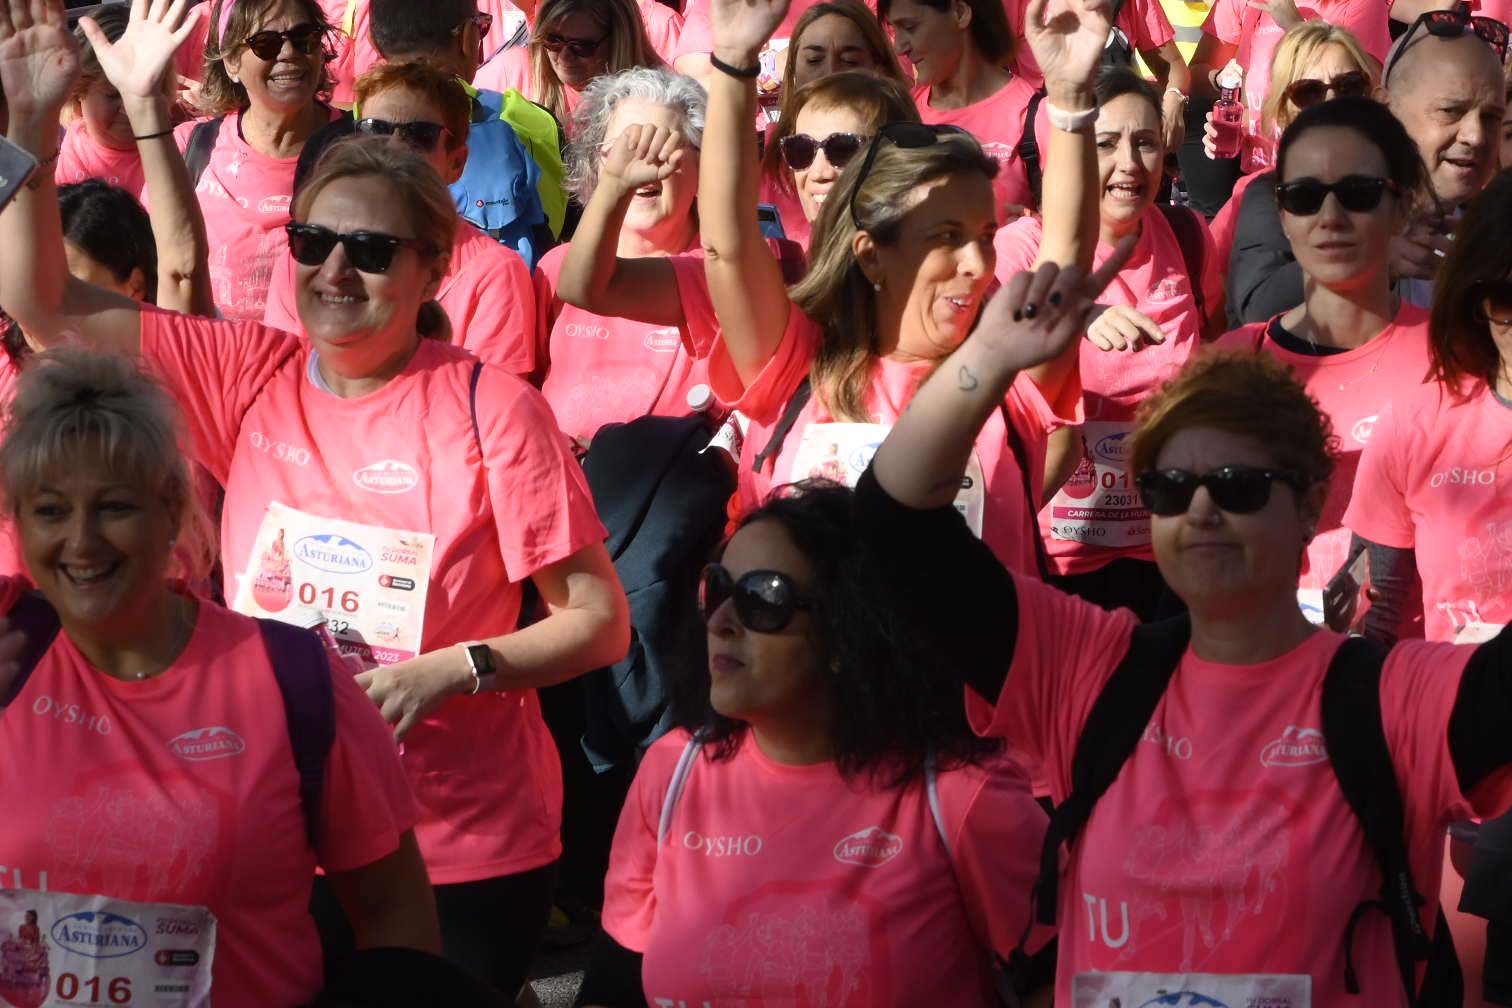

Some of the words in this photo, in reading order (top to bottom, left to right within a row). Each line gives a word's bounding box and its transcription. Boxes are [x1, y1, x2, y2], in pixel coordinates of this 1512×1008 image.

[250, 431, 311, 466] OYSHO
[1101, 471, 1129, 489] 01
[1063, 525, 1106, 537] OYSHO
[300, 543, 367, 569] ASTURIANA
[380, 552, 418, 566] SUMA
[298, 582, 360, 613] 016
[374, 649, 400, 662] 2023
[32, 695, 112, 735] OYSHO
[683, 831, 763, 857] OYSHO
[1083, 893, 1130, 949] TU
[58, 924, 139, 947] ASTURIANA
[56, 972, 133, 1003] 016
